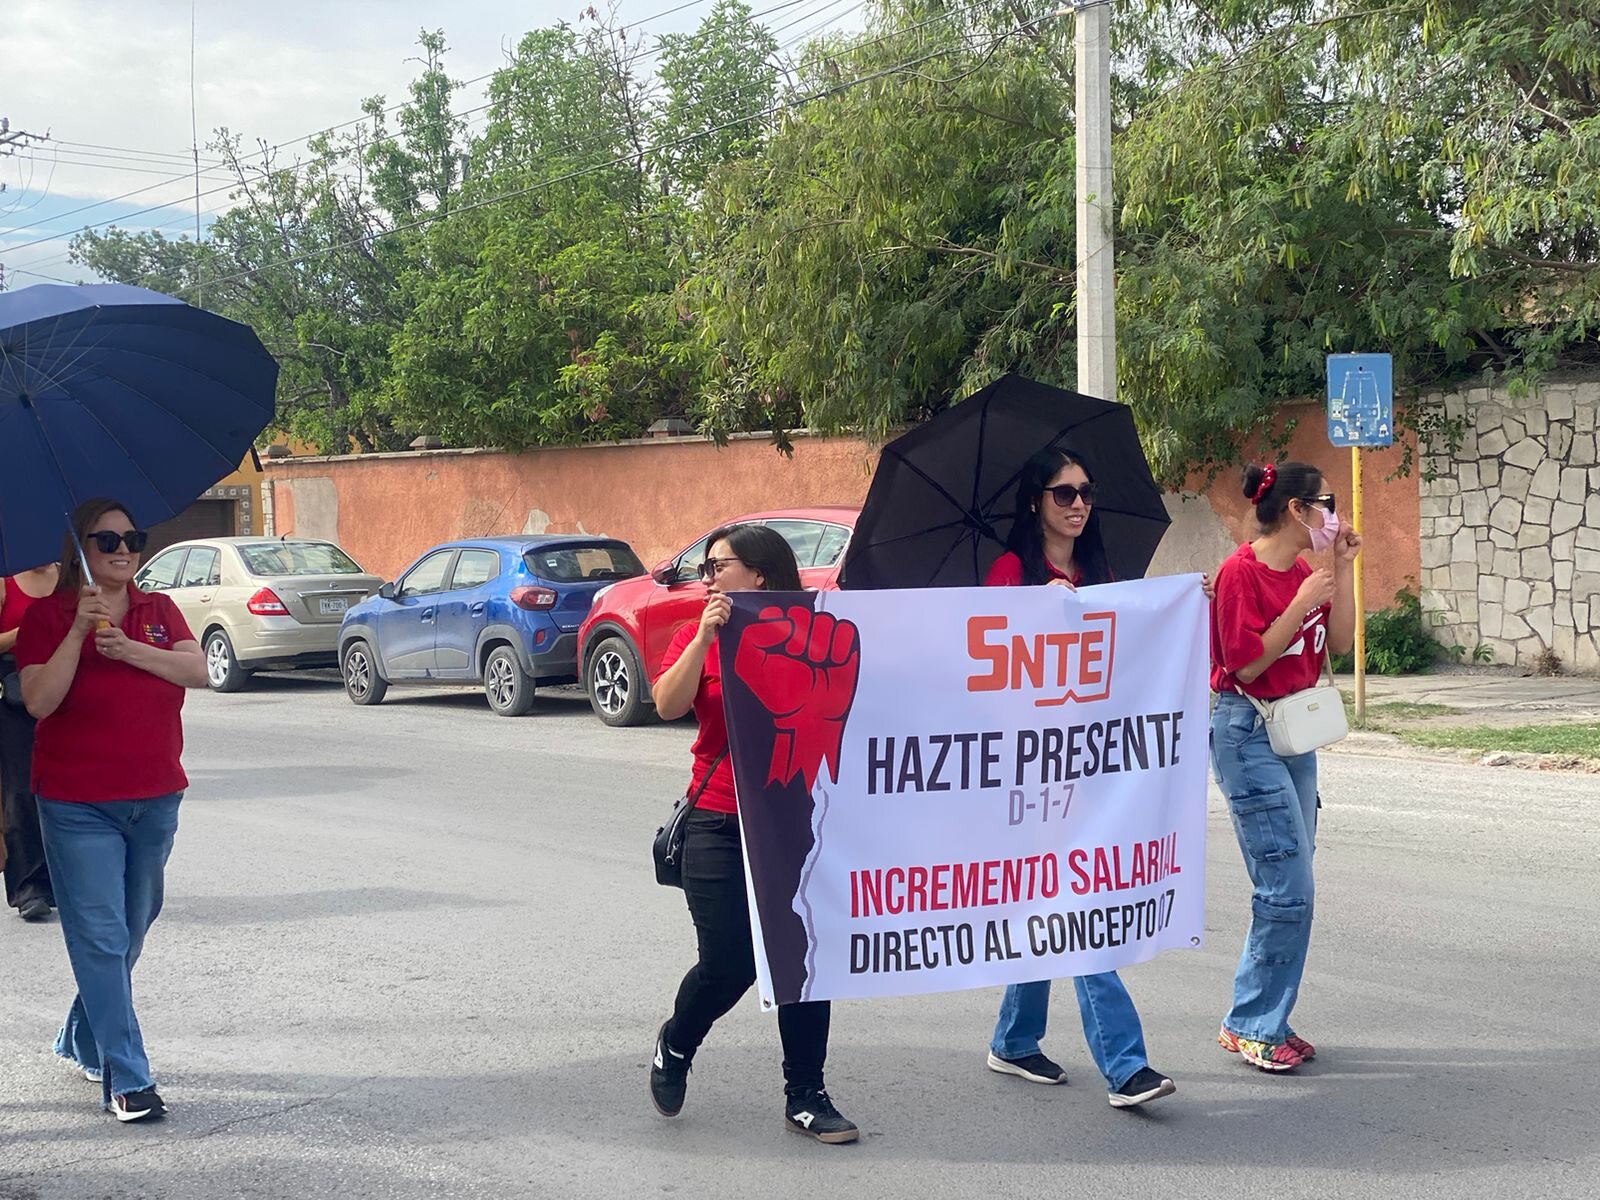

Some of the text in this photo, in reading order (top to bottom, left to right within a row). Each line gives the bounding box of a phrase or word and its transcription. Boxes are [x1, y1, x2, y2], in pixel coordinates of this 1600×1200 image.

[967, 616, 1104, 692] SNTE
[868, 711, 1184, 794] HAZTE PRESENTE
[1008, 784, 1075, 826] D-1-7
[850, 832, 1181, 918] INCREMENTO SALARIAL
[850, 889, 1175, 974] DIRECTO AL CONCEPTO 07
